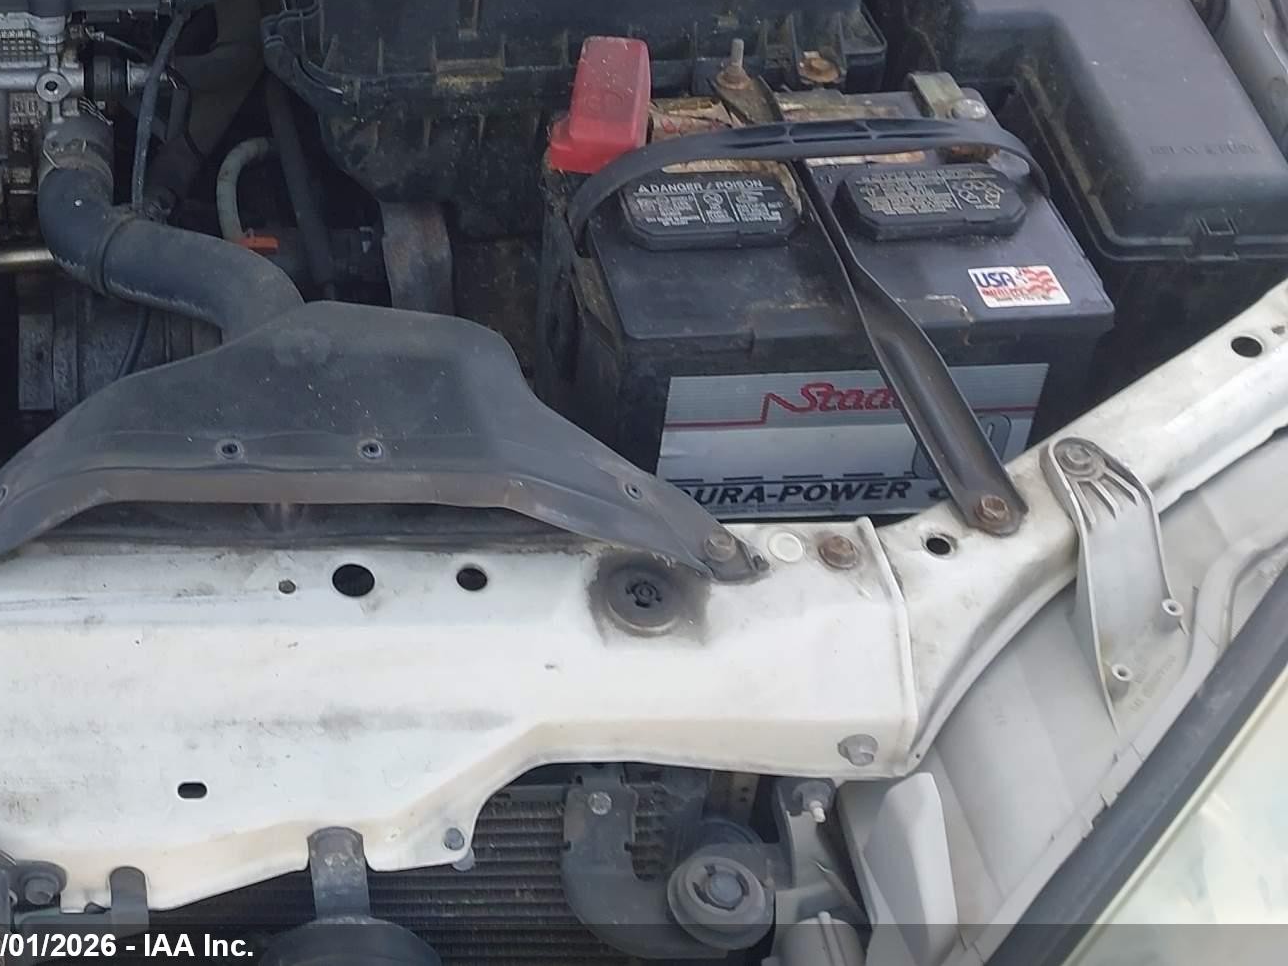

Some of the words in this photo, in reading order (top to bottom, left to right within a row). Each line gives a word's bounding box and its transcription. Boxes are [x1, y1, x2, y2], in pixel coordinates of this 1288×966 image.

[649, 183, 703, 193] DANGER
[715, 179, 764, 191] POISON
[973, 272, 1016, 288] USA
[800, 382, 901, 411] Staa
[679, 481, 912, 506] URA-POWER
